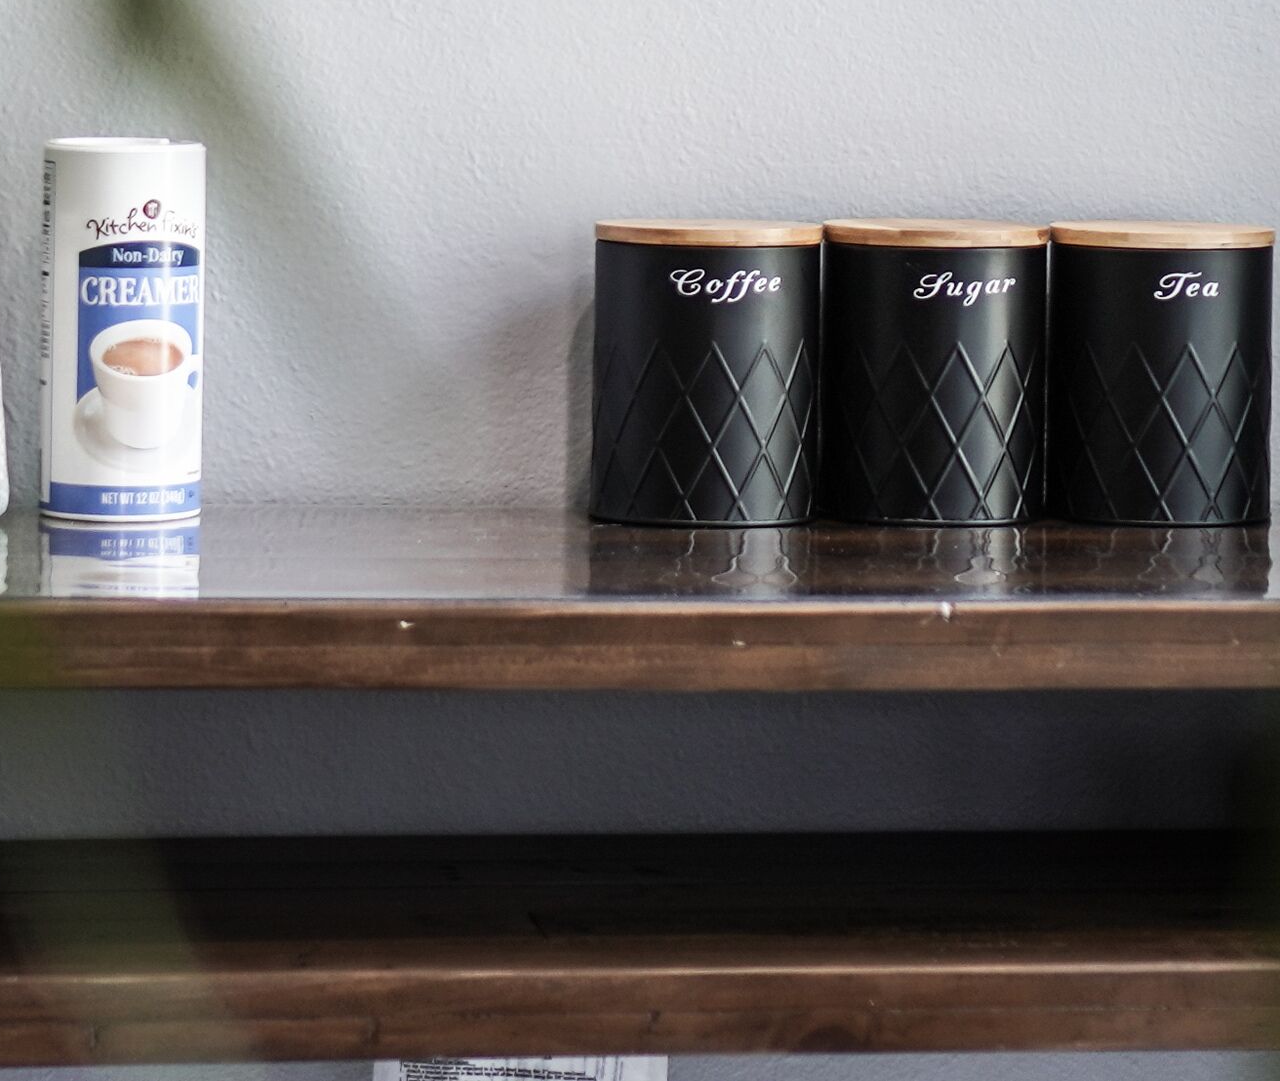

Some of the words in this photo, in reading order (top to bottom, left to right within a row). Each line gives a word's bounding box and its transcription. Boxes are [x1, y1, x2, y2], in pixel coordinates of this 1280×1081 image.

[86, 208, 157, 240] Kitchen
[81, 275, 200, 306] CREAMER
[669, 268, 782, 303] Coffee
[913, 271, 1017, 307] Sugar
[1153, 271, 1219, 300] Tea
[102, 492, 118, 504] NET
[136, 492, 147, 504] 12
